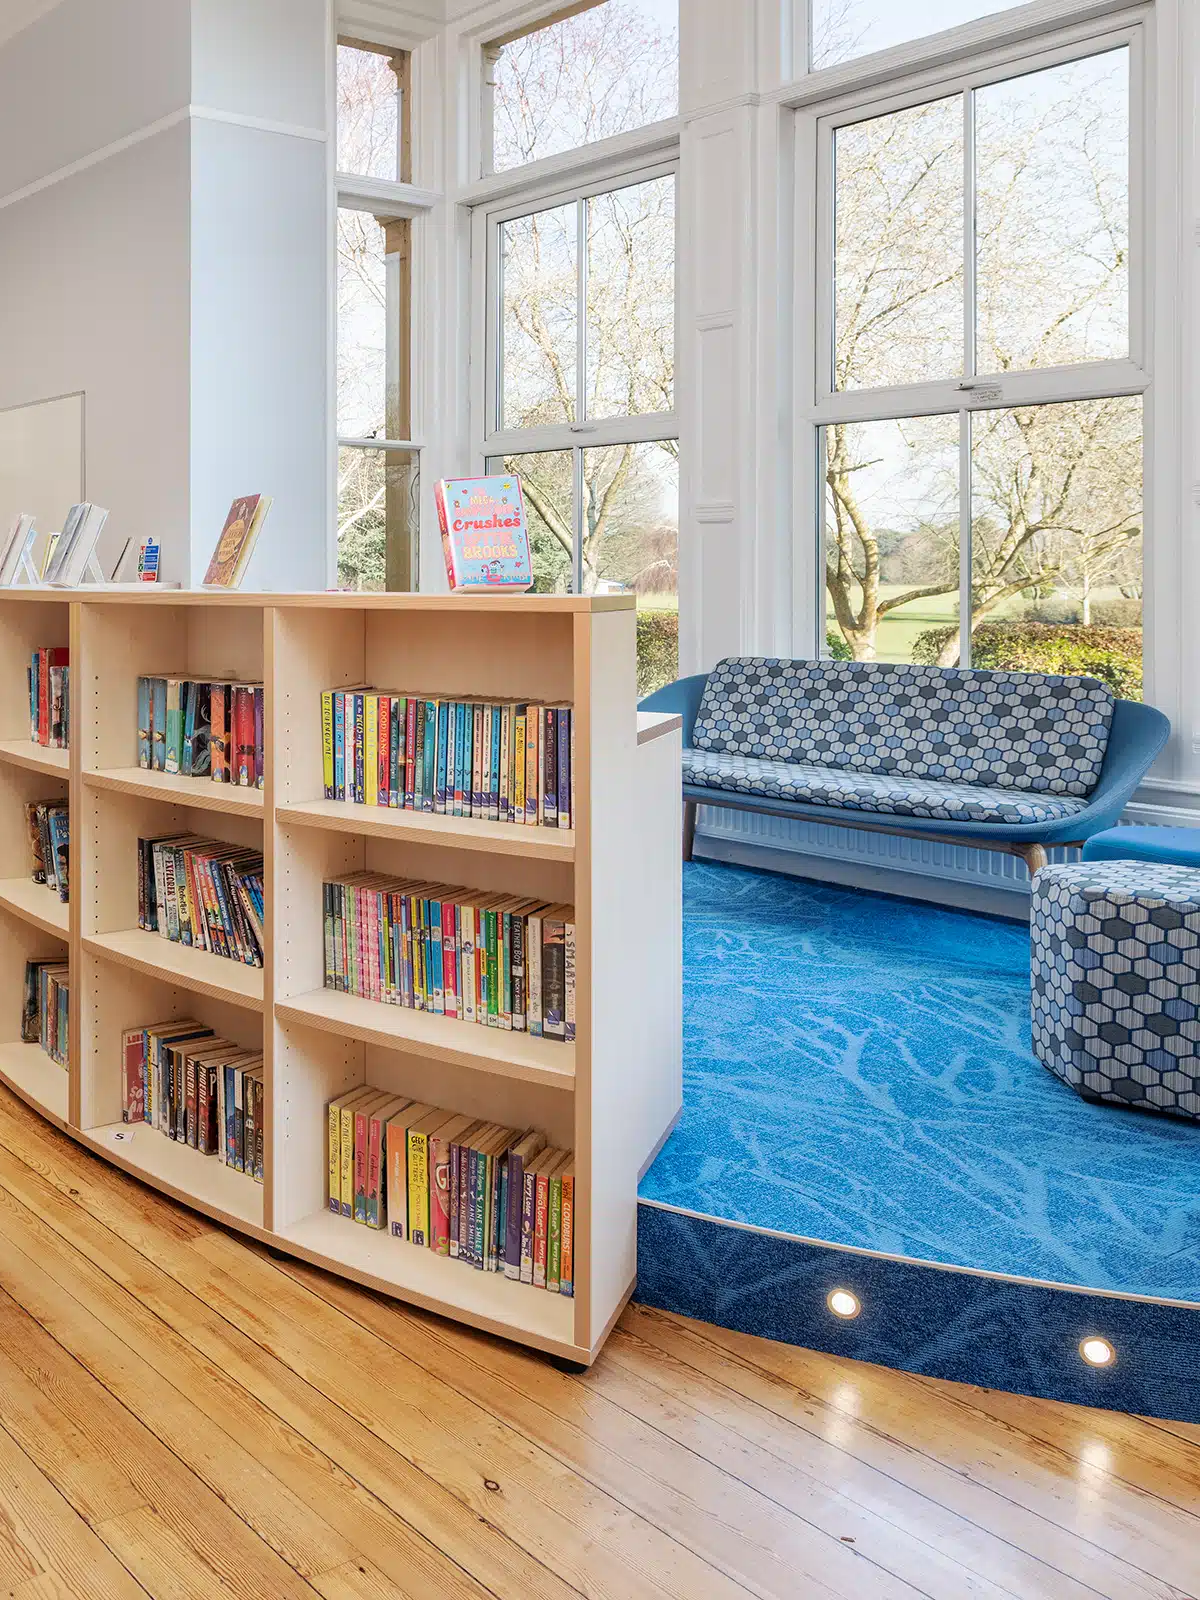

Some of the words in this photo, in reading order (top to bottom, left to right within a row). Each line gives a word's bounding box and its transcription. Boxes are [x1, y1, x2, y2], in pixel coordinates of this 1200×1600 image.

[453, 514, 520, 532] Crushes
[462, 545, 519, 560] BROOKS
[380, 701, 388, 729] FLOOD
[379, 732, 388, 756] FANG
[165, 860, 176, 896] EXPLORER
[513, 921, 521, 948] FEATHER
[514, 950, 522, 964] BOY
[566, 941, 575, 988] SMART
[187, 1059, 195, 1098] PHOENIX
[199, 1066, 207, 1105] PHOENIX
[411, 1136, 425, 1144] GEEK
[525, 1175, 533, 1196] Barry
[536, 1207, 545, 1228] Loser
[551, 1208, 559, 1229] Loser
[562, 1202, 571, 1255] CLOUDBURST
